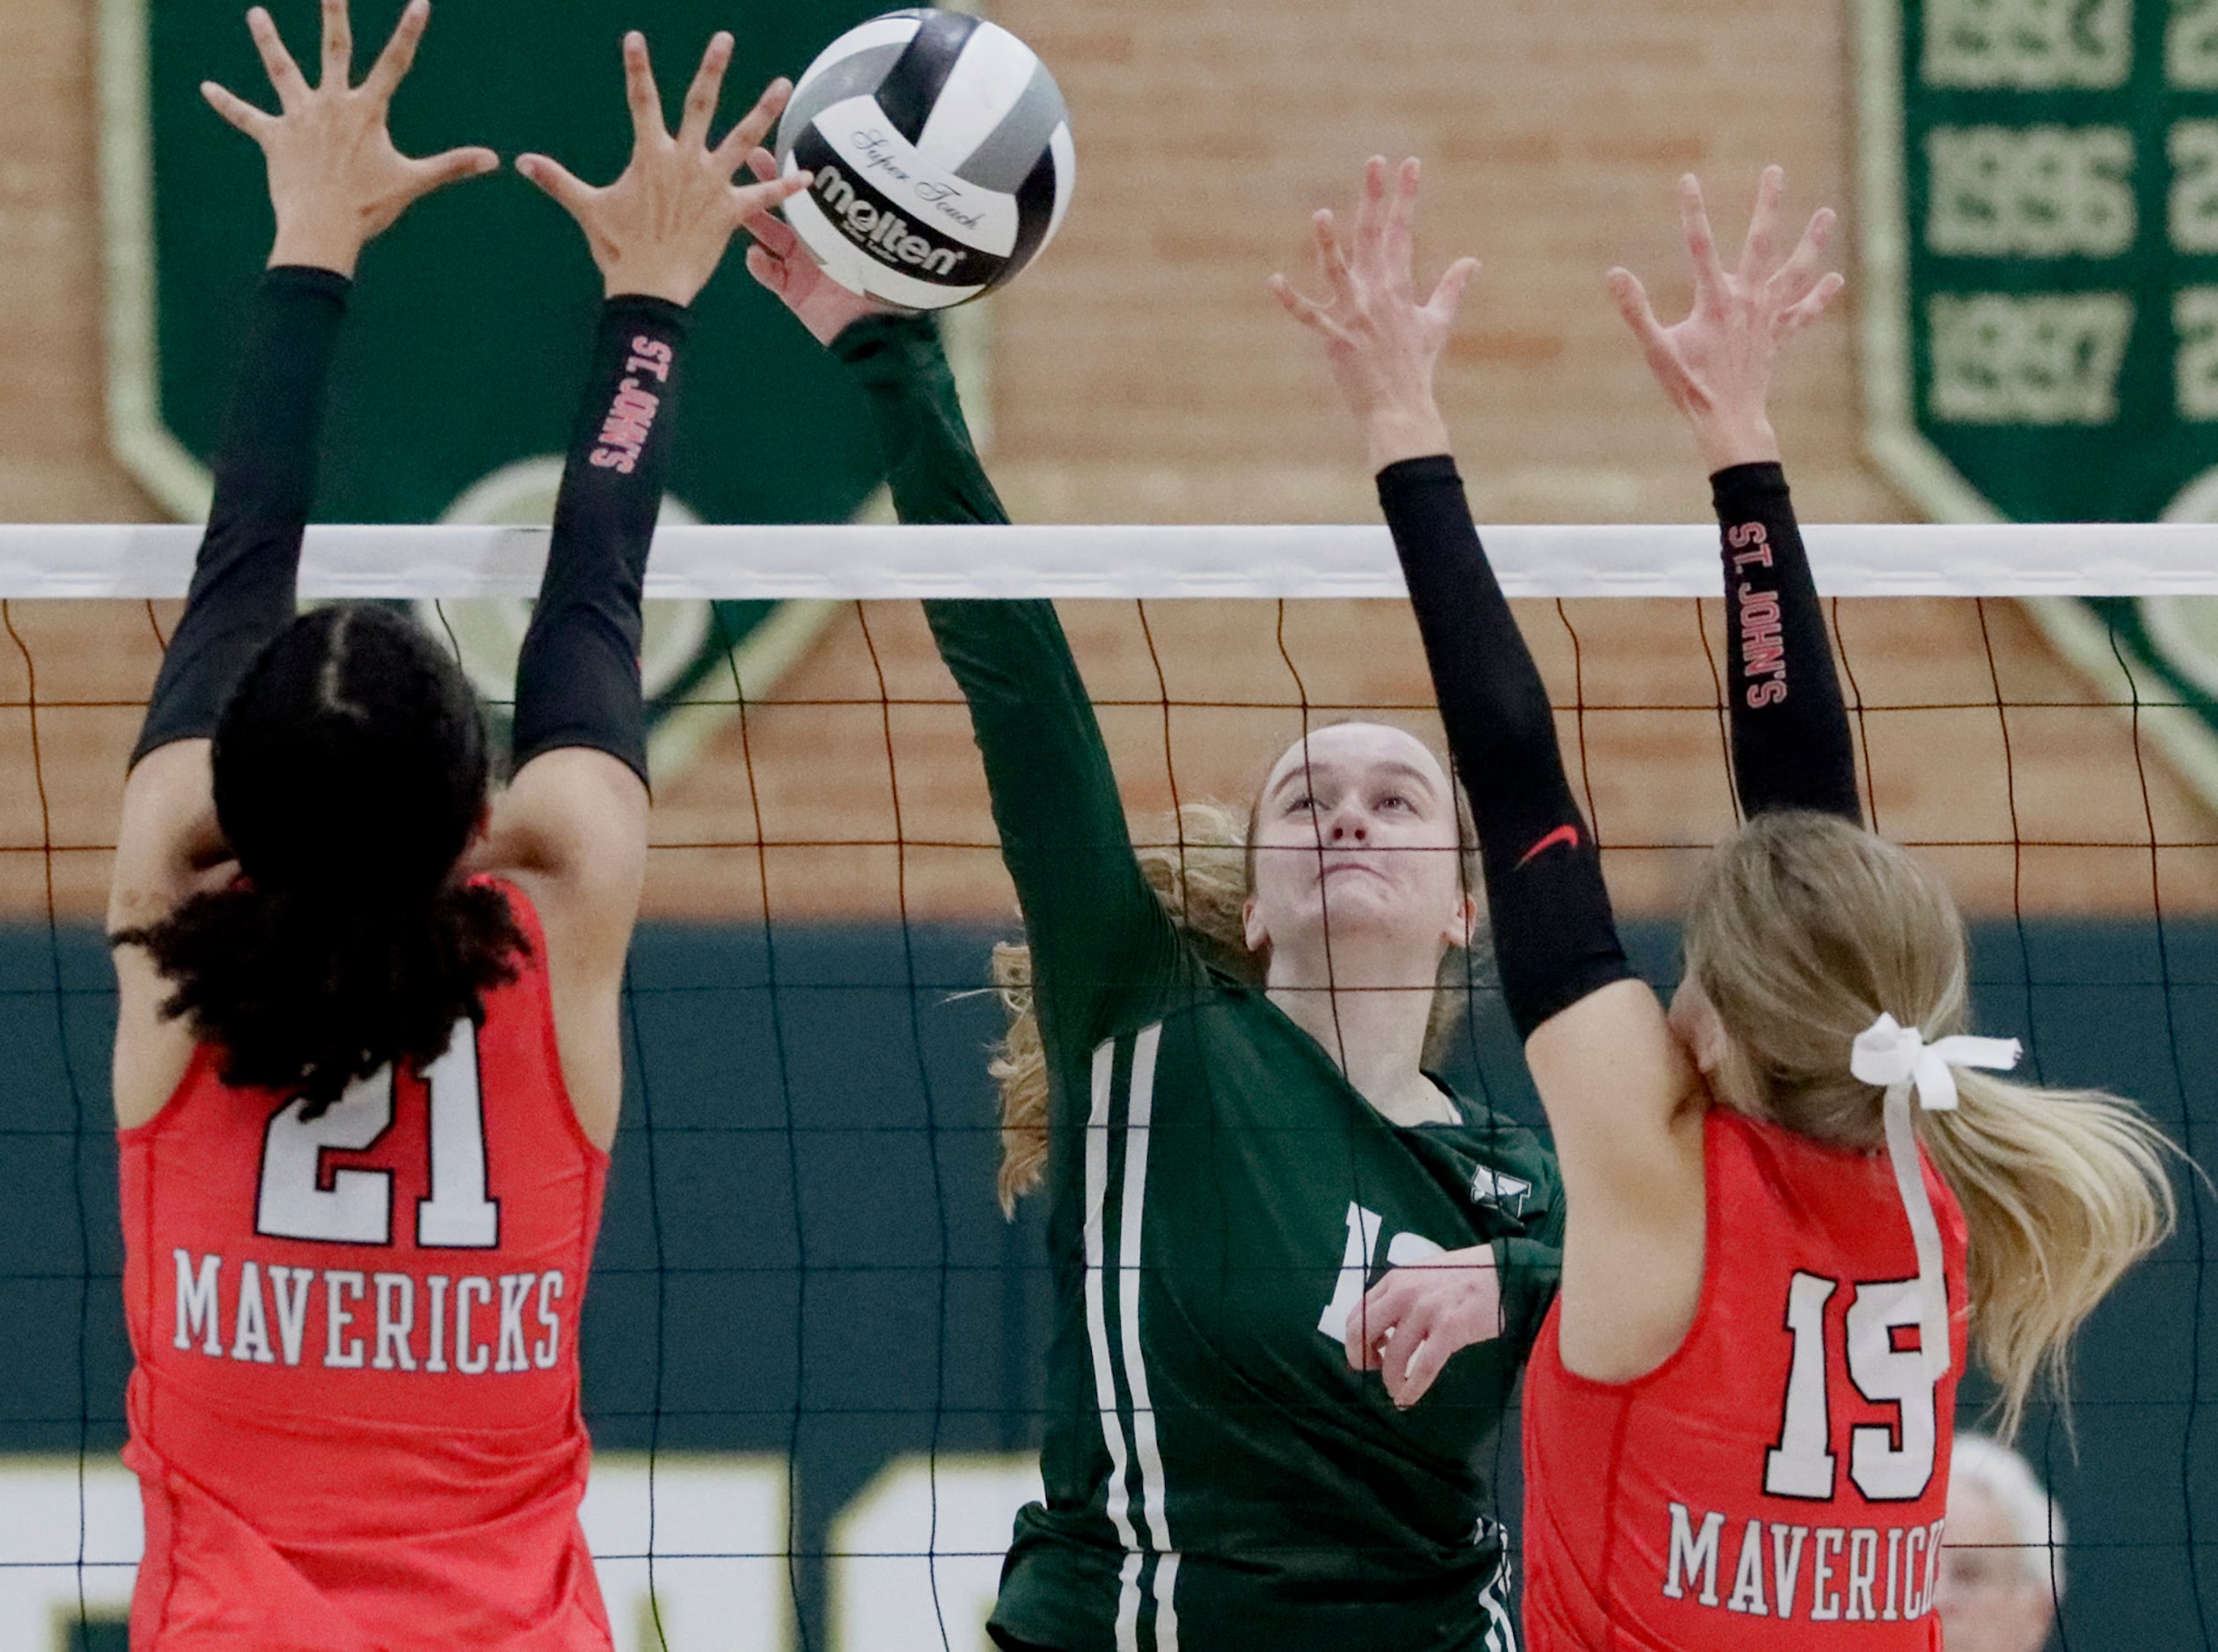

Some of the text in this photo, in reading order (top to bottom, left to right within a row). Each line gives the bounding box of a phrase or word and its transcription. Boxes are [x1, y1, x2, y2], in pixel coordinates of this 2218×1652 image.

[814, 164, 958, 276] molten
[850, 129, 986, 230] Super Touch
[1926, 123, 2138, 257] 1996
[1929, 291, 2134, 425] 1997
[1728, 521, 1787, 709] ST. JOHN'S
[254, 1017, 501, 1250] 21
[173, 1247, 564, 1375] MAVERICKS
[1763, 1268, 1949, 1503] 19
